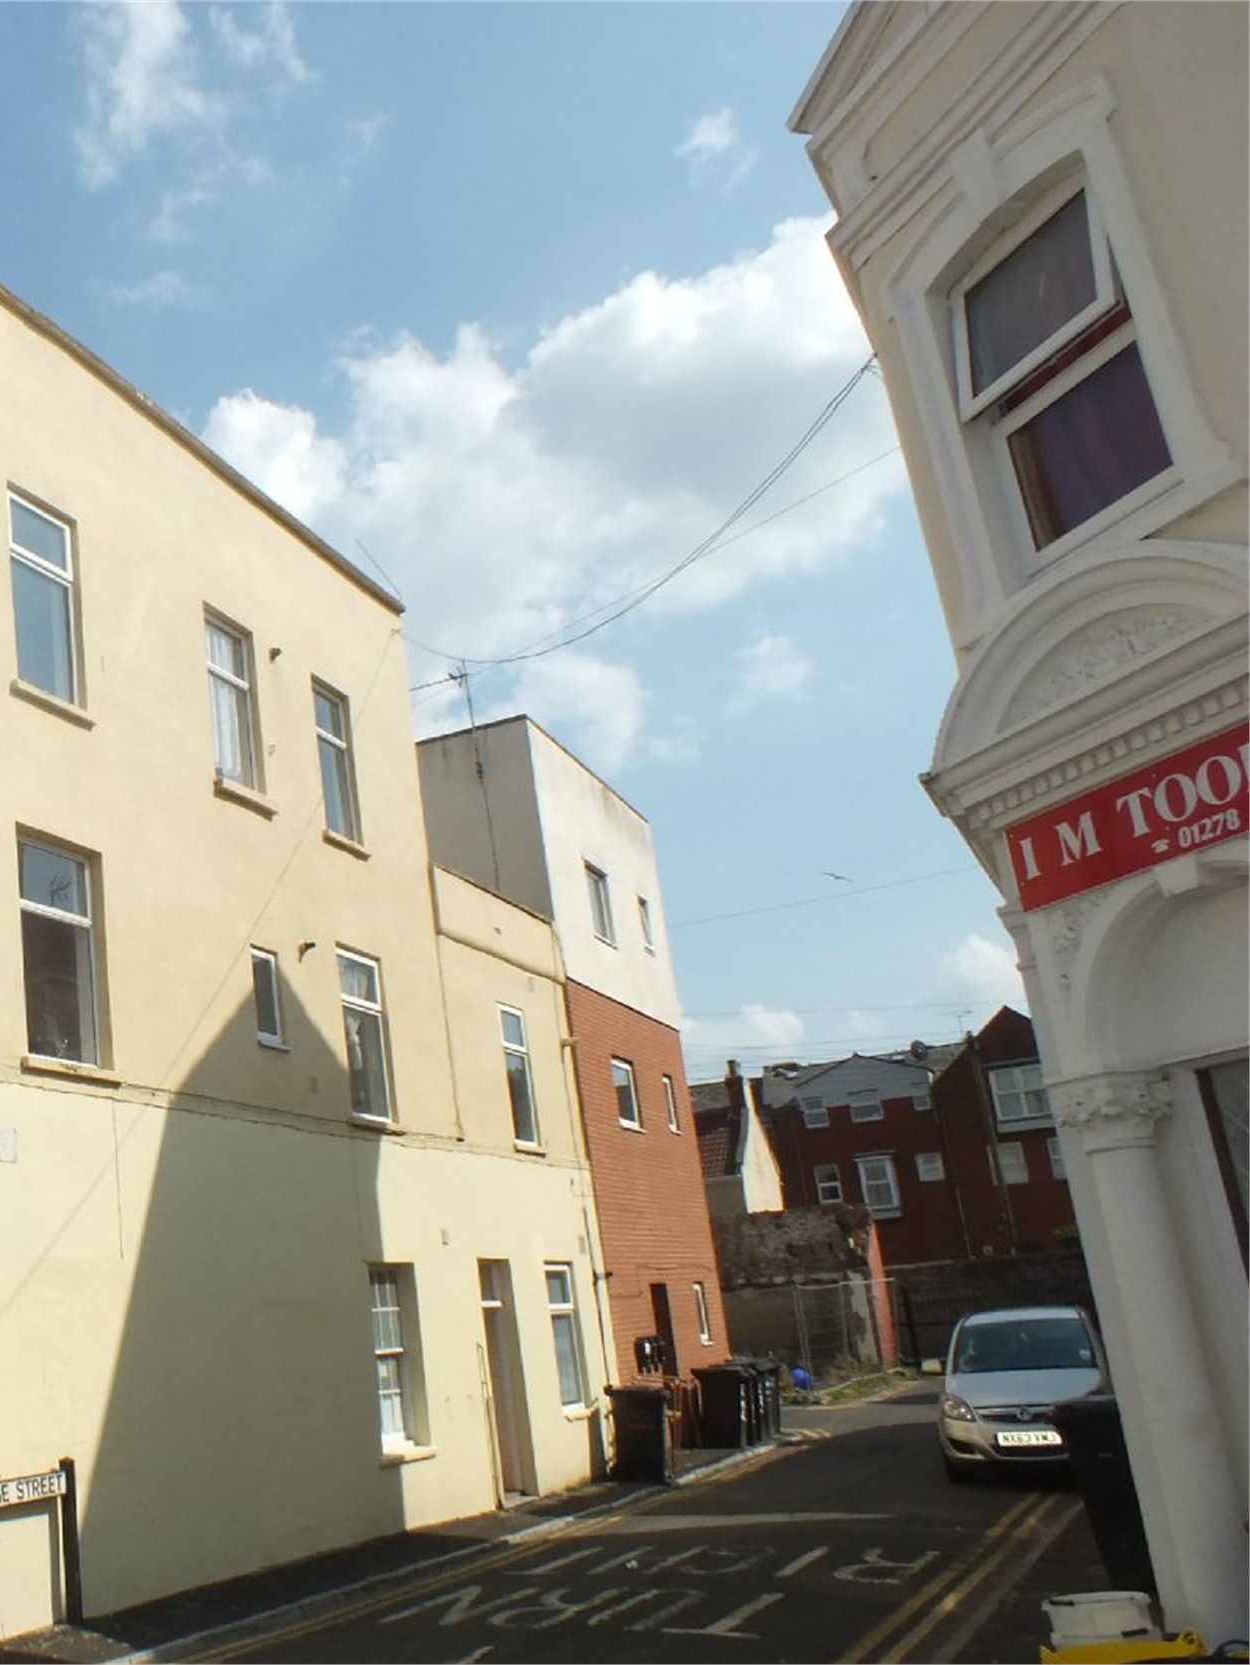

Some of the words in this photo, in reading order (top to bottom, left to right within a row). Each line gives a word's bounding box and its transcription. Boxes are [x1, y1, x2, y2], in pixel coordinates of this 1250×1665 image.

[1019, 836, 1041, 881] I
[1054, 811, 1104, 867] M
[1178, 808, 1240, 848] 01278
[16, 1473, 63, 1500] STREET
